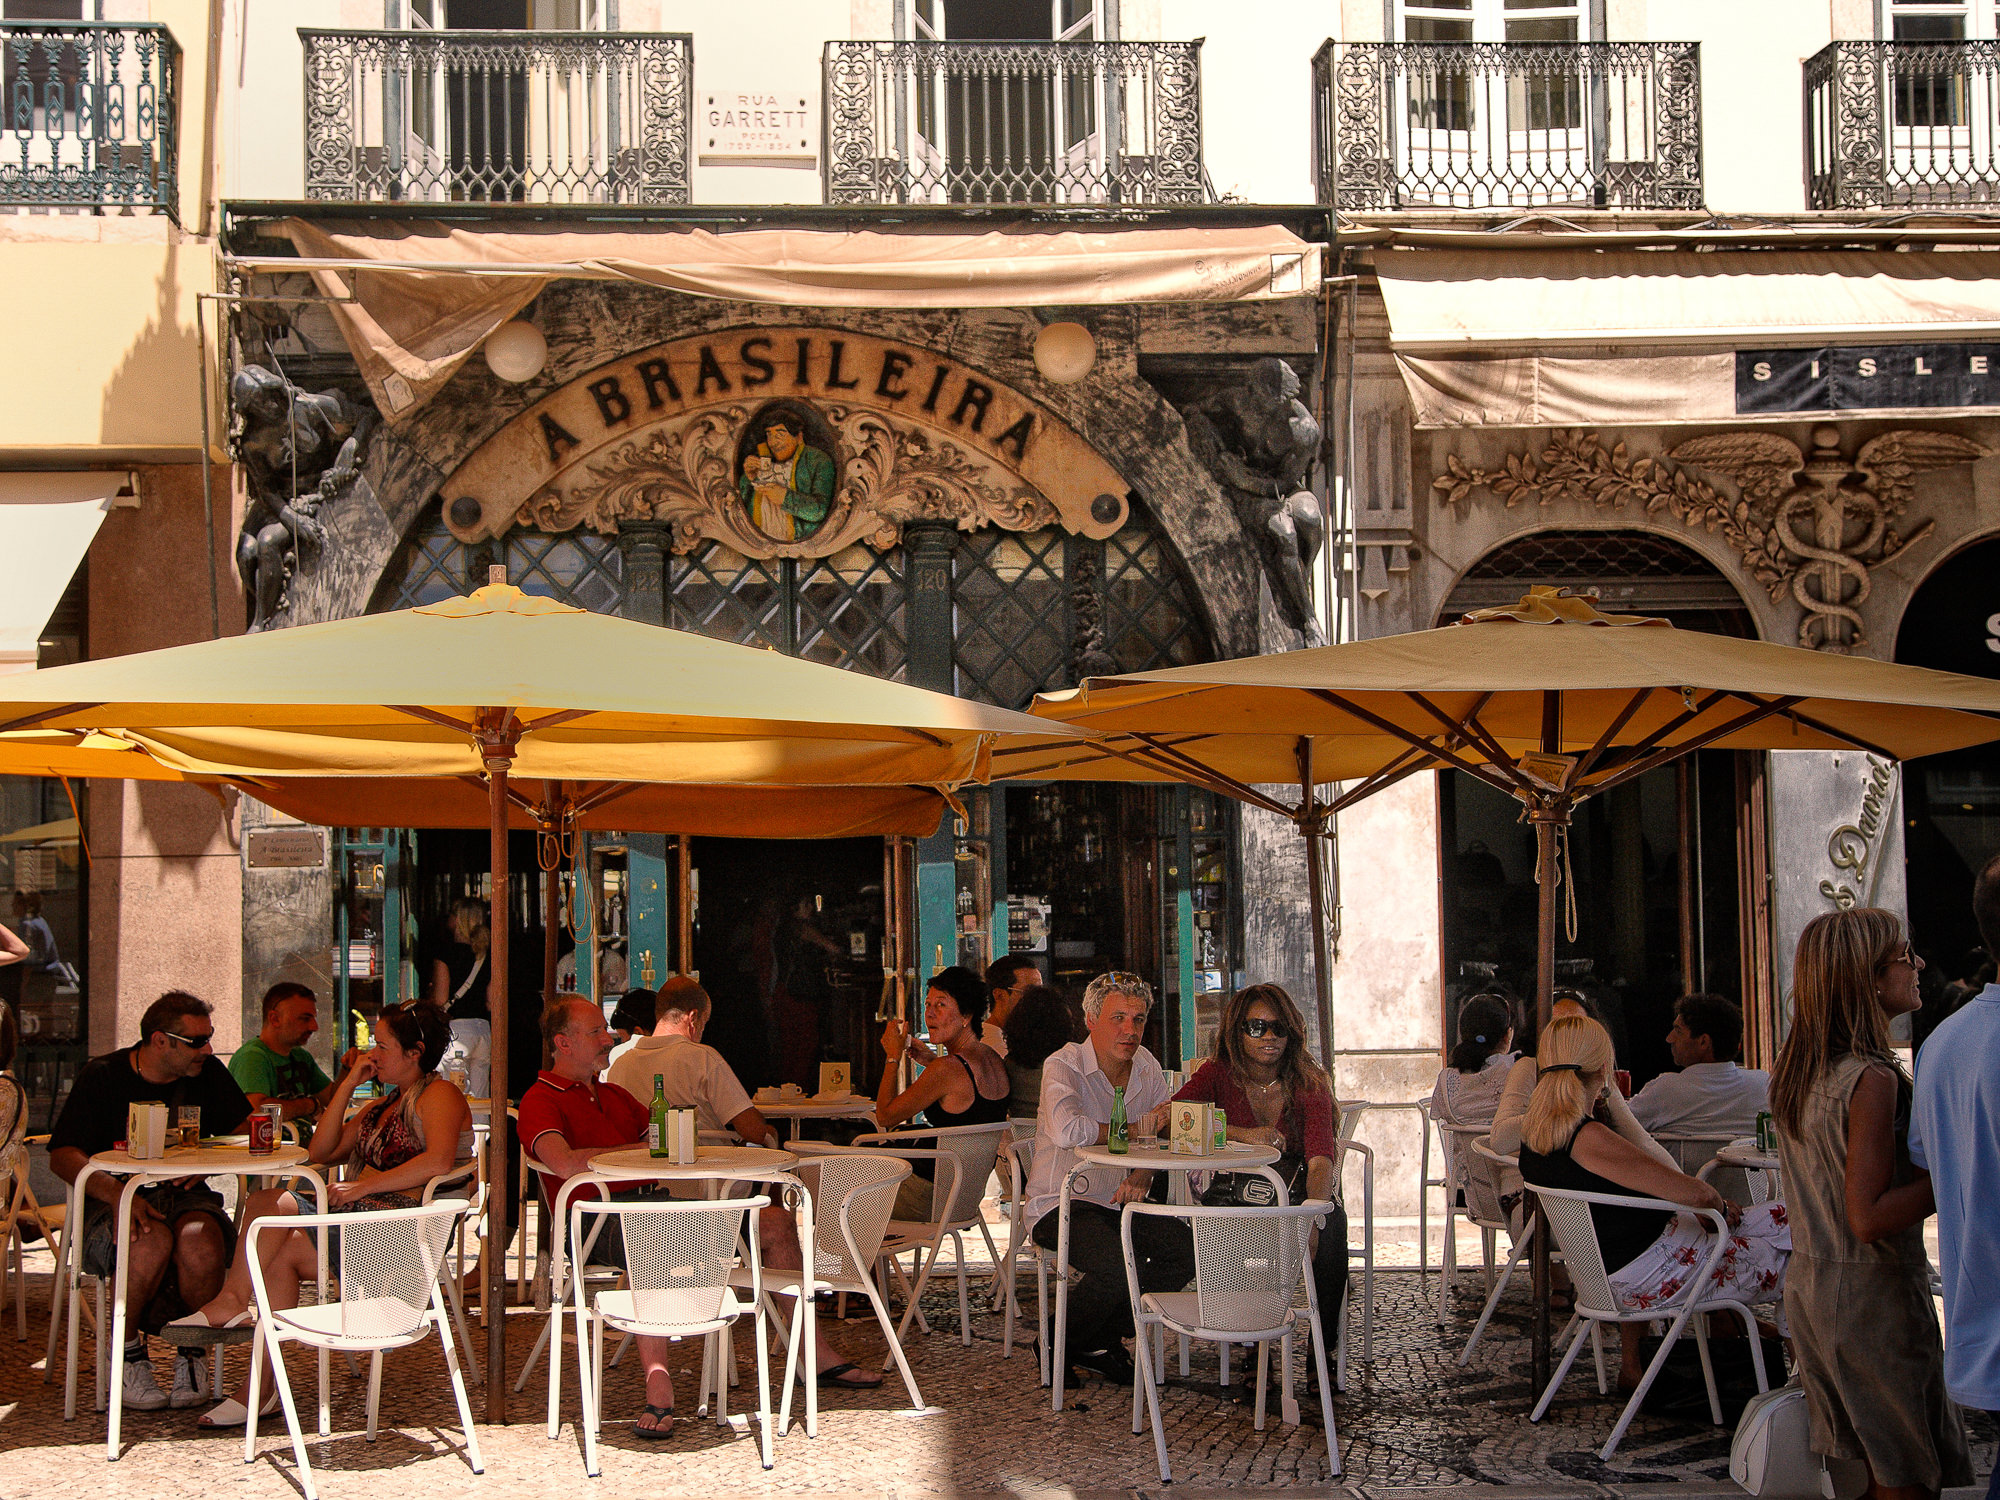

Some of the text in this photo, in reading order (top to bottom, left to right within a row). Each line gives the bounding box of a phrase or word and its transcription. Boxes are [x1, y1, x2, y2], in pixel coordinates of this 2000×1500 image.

[738, 95, 778, 106] RUA
[708, 110, 808, 128] GARRETT
[1752, 355, 1990, 382] SISLE
[538, 337, 1037, 462] A BRASILEIRA
